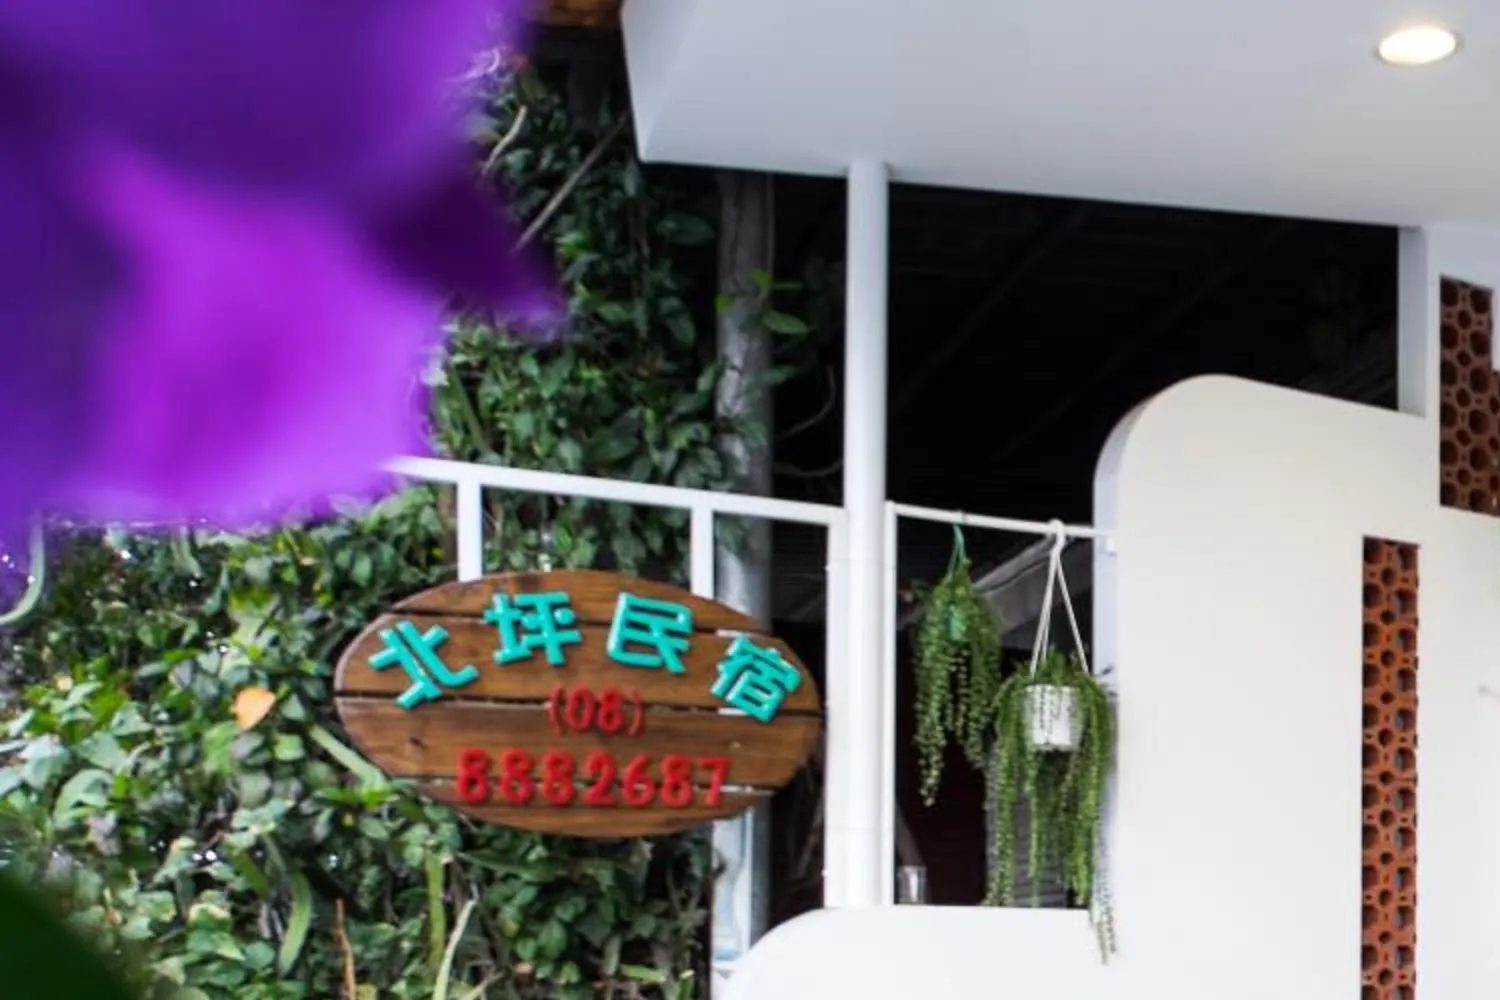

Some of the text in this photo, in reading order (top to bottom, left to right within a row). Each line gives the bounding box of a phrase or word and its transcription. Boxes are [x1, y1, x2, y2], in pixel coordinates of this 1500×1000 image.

[367, 591, 802, 723] 北坪民宿
[548, 685, 646, 736] (08)
[456, 747, 732, 808] 8882687
